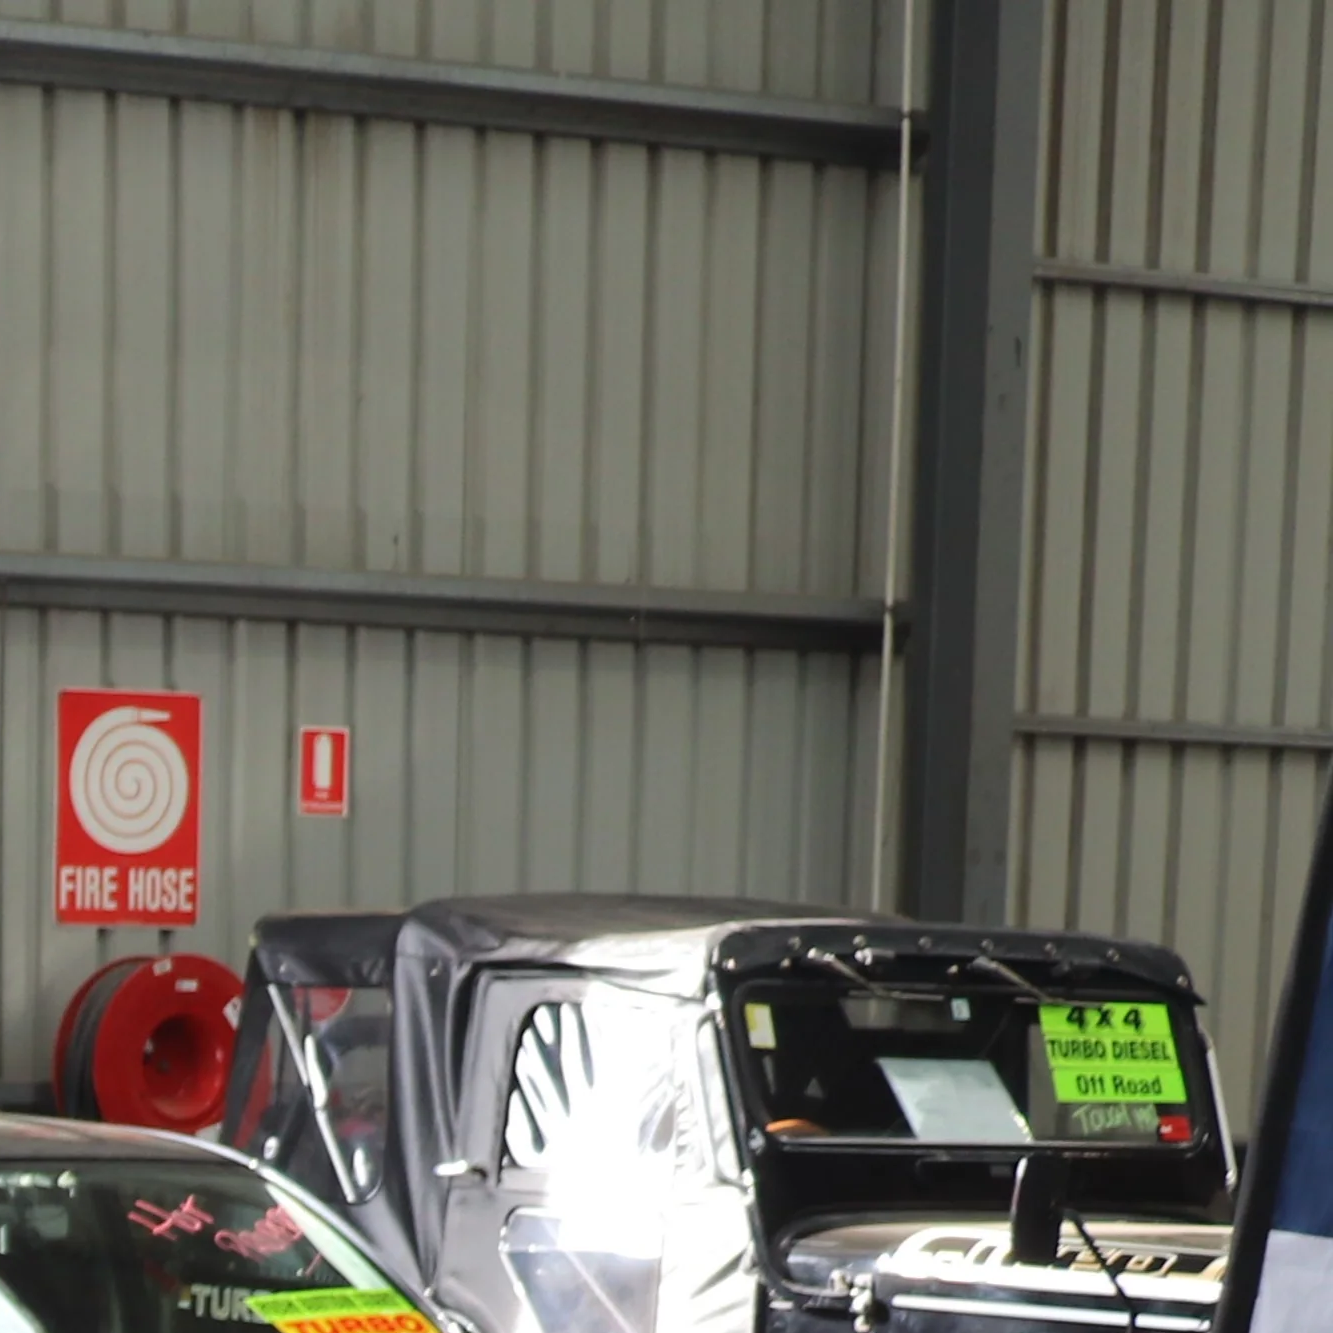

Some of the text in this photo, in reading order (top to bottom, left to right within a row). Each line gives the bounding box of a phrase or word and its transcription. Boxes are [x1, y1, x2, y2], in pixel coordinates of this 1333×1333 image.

[59, 866, 194, 912] FIRE HOSE
[1066, 1006, 1084, 1030] 4
[1123, 1008, 1143, 1030] 4
[1048, 1039, 1171, 1060] TURBO DIESEL
[1076, 1075, 1162, 1094] Off Road
